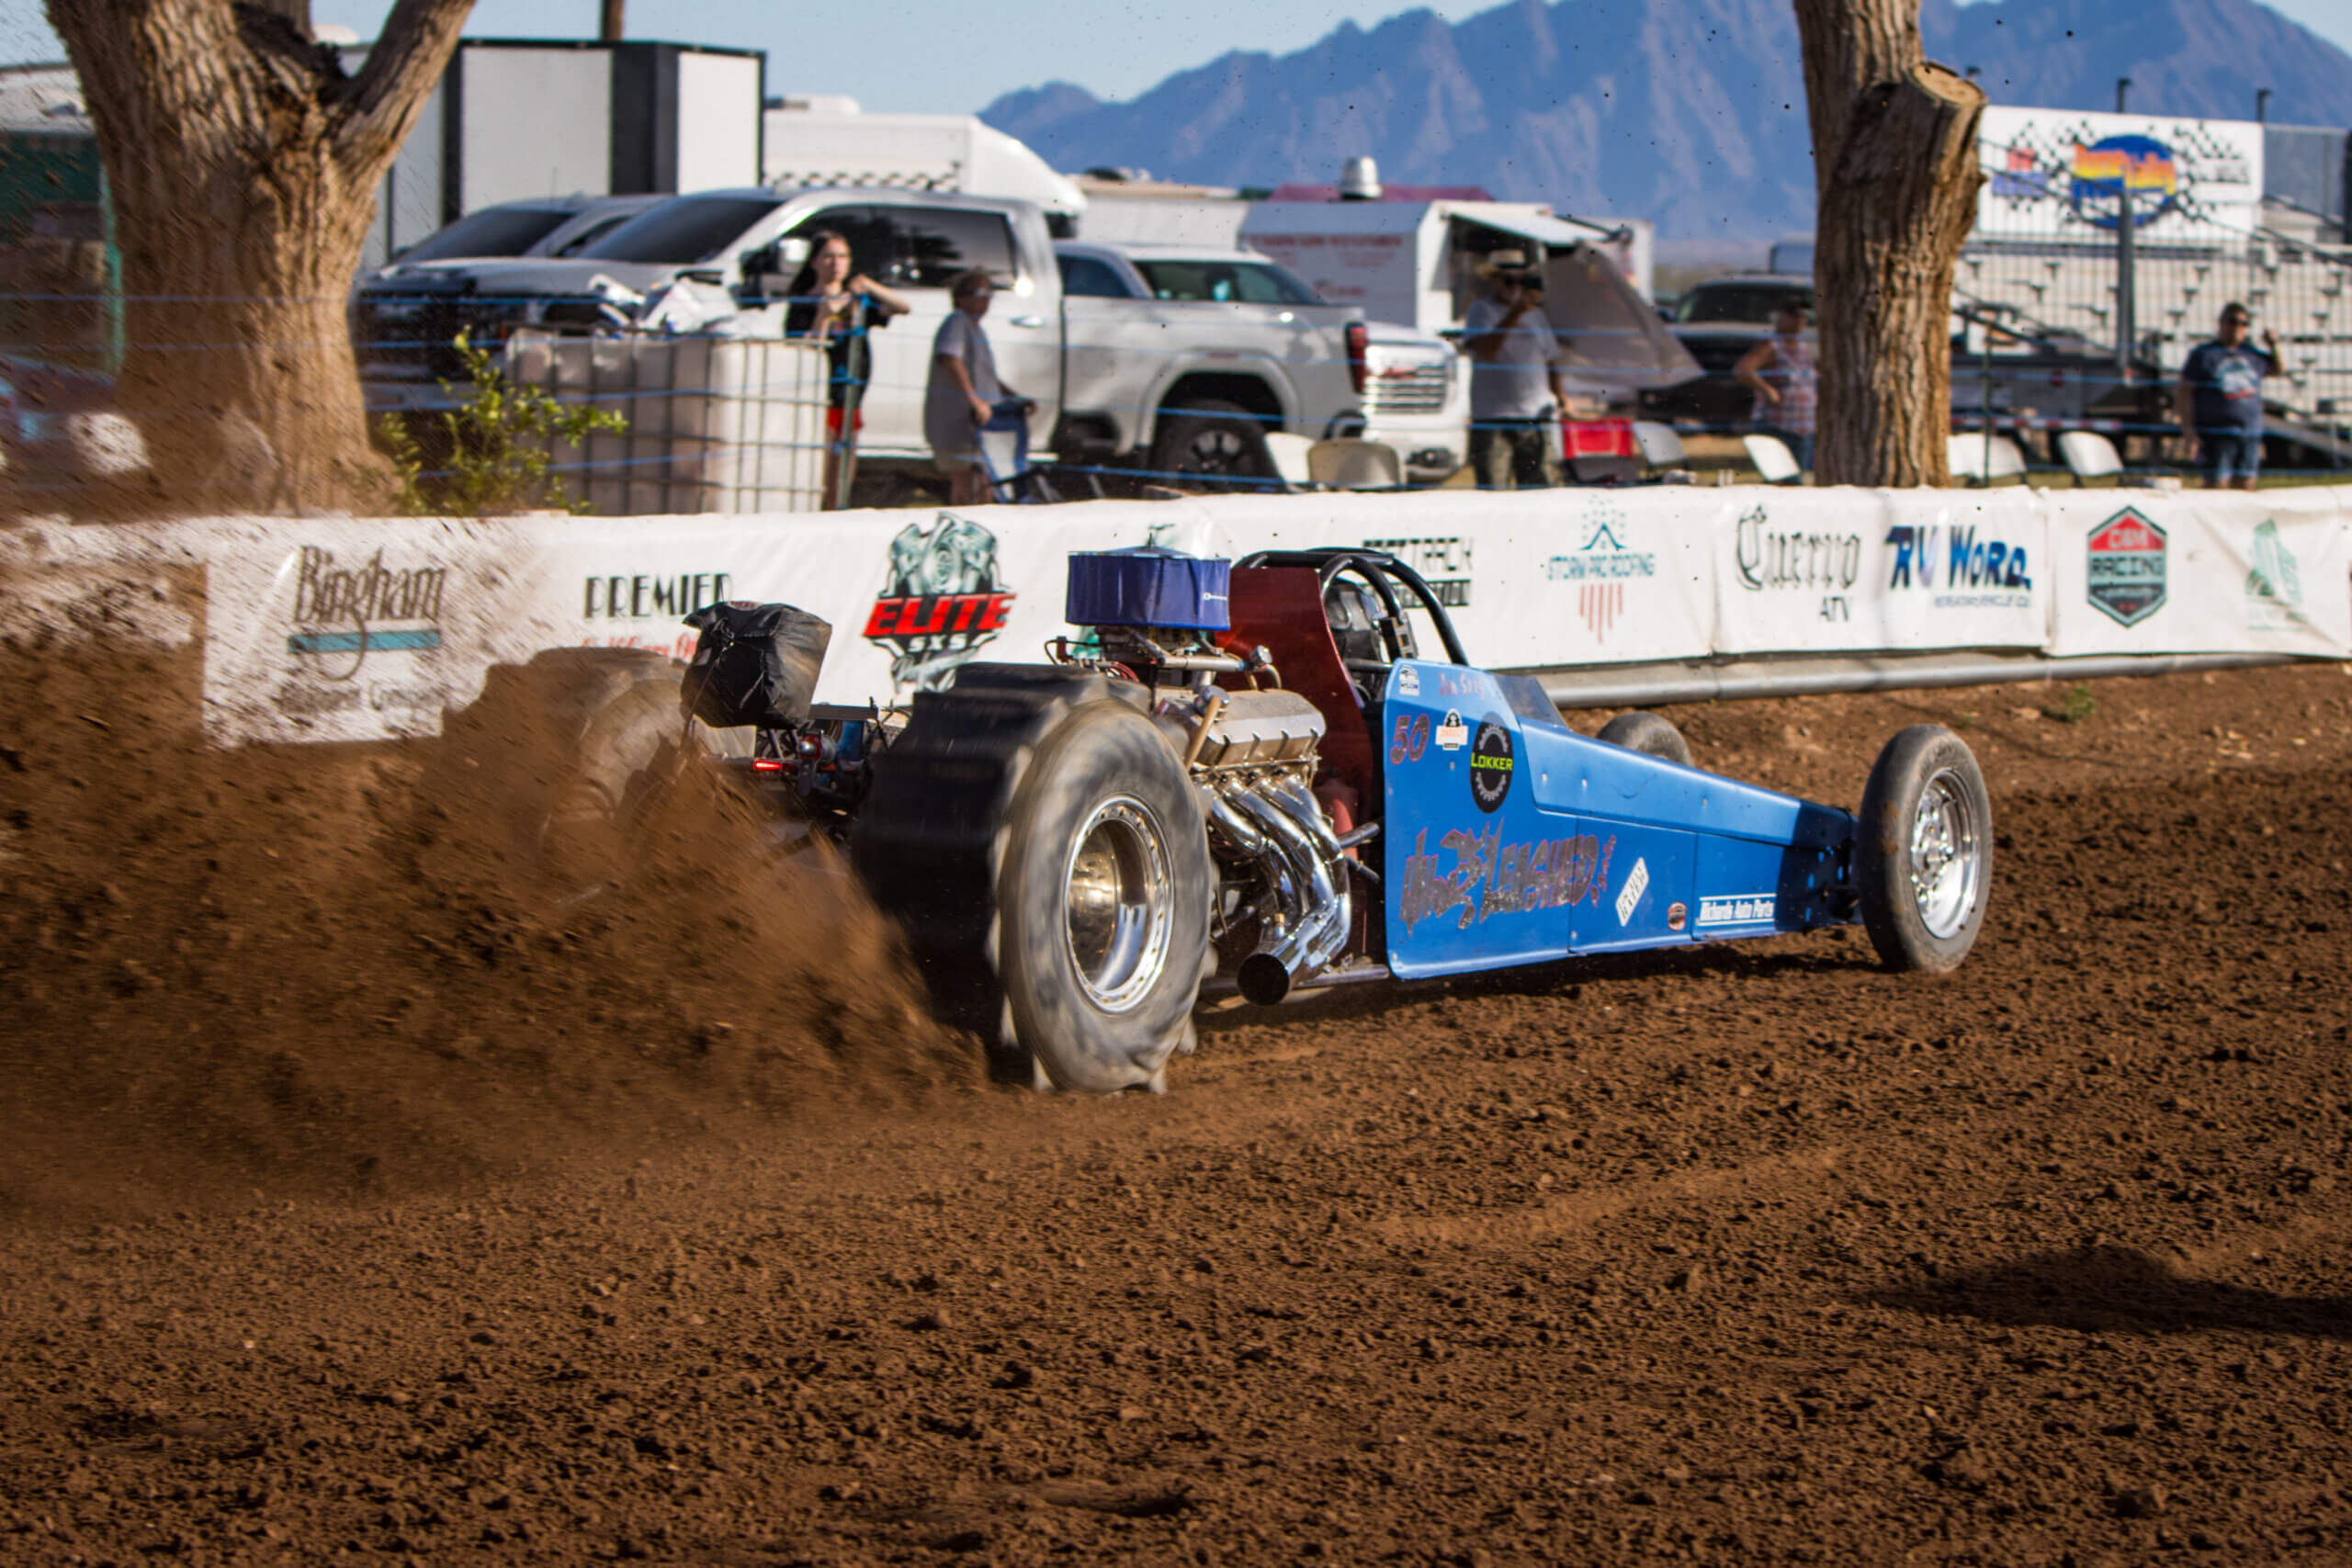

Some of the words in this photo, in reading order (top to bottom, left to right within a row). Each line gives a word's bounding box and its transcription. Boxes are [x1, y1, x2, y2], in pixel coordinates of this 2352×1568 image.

[1884, 525, 1939, 590] RV
[292, 545, 447, 682] Bingham
[582, 572, 733, 620] PREMIER
[862, 593, 1017, 637] ELITE
[1390, 713, 1430, 764] 50
[1470, 752, 1514, 772] LOKKER
